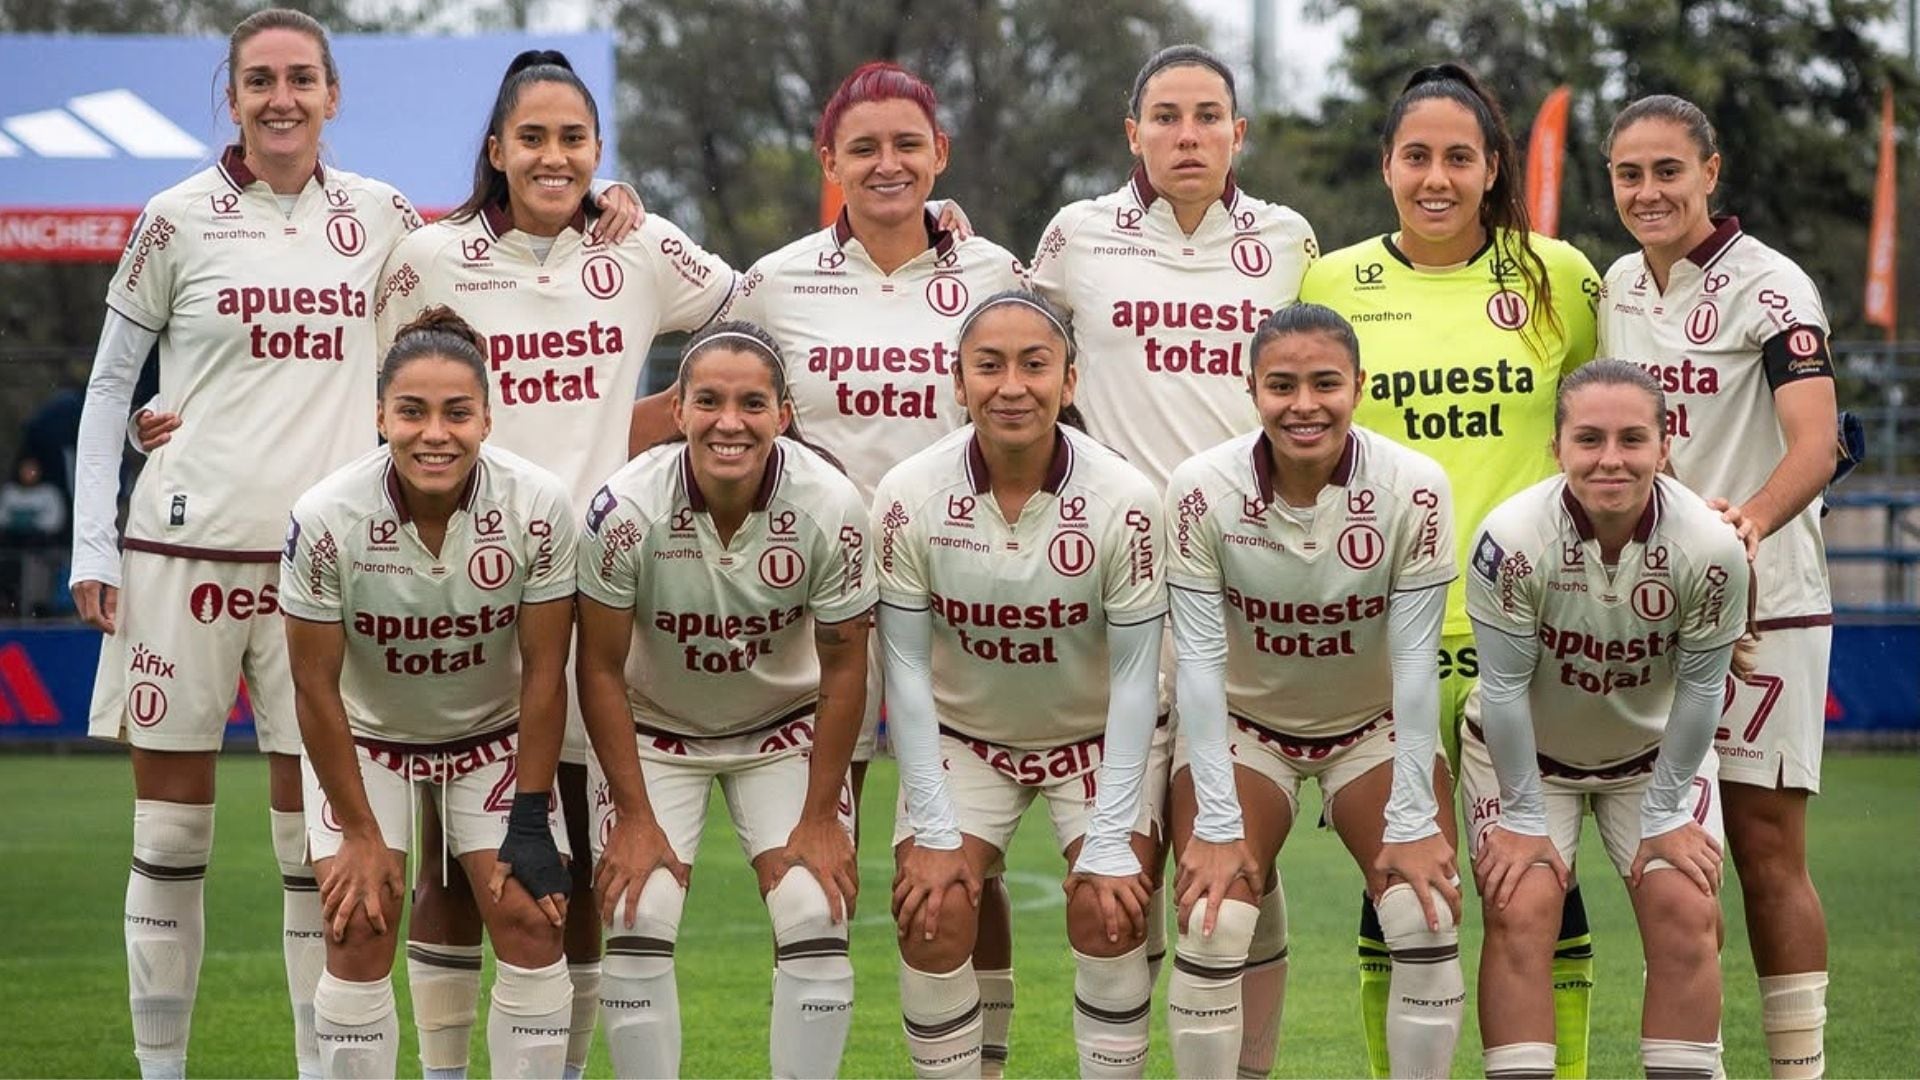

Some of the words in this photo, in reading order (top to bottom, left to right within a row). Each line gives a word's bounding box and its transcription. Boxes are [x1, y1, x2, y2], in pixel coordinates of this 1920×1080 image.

[210, 192, 240, 214] b2
[1116, 207, 1143, 230] b2
[153, 223, 177, 251] 365
[203, 228, 266, 241] marathon
[126, 214, 167, 293] mascotas
[462, 238, 491, 261] b2
[1093, 244, 1157, 257] marathon
[397, 270, 420, 297] 365
[455, 279, 517, 293] marathon
[1355, 262, 1384, 284] b2
[217, 282, 366, 323] apuesta
[793, 284, 858, 295] marathon
[1351, 310, 1412, 323] marathon
[250, 325, 344, 361] total
[490, 320, 624, 371] puesta
[1145, 338, 1243, 376] total
[499, 366, 600, 405] total
[1371, 359, 1534, 407] apuesta
[1641, 359, 1718, 394] esta
[836, 383, 937, 419] total
[1404, 403, 1503, 440] total
[947, 494, 975, 521] b2
[1060, 496, 1086, 521] b2
[1348, 489, 1375, 514] b2
[369, 520, 397, 544] b2
[475, 510, 504, 535] b2
[769, 511, 796, 535] b2
[654, 548, 703, 561] maratho
[929, 536, 990, 553] marathon
[1223, 532, 1286, 553] marathon
[353, 560, 414, 576] marathon
[1644, 546, 1668, 570] b2
[227, 584, 286, 620] es
[931, 592, 1089, 630] apuesta
[1227, 586, 1386, 625] apuesta
[354, 604, 516, 645] apuesta
[655, 605, 803, 643] apuesta
[959, 627, 1058, 663] total
[1254, 626, 1355, 658] total
[1540, 622, 1678, 663] apuesta
[385, 642, 486, 675] total
[1439, 645, 1479, 678] es
[1473, 797, 1501, 824] Afi
[125, 913, 178, 929] rathon
[286, 929, 323, 939] mara
[1554, 979, 1594, 991] atho
[599, 998, 652, 1009] rathon
[511, 1025, 570, 1037] marath
